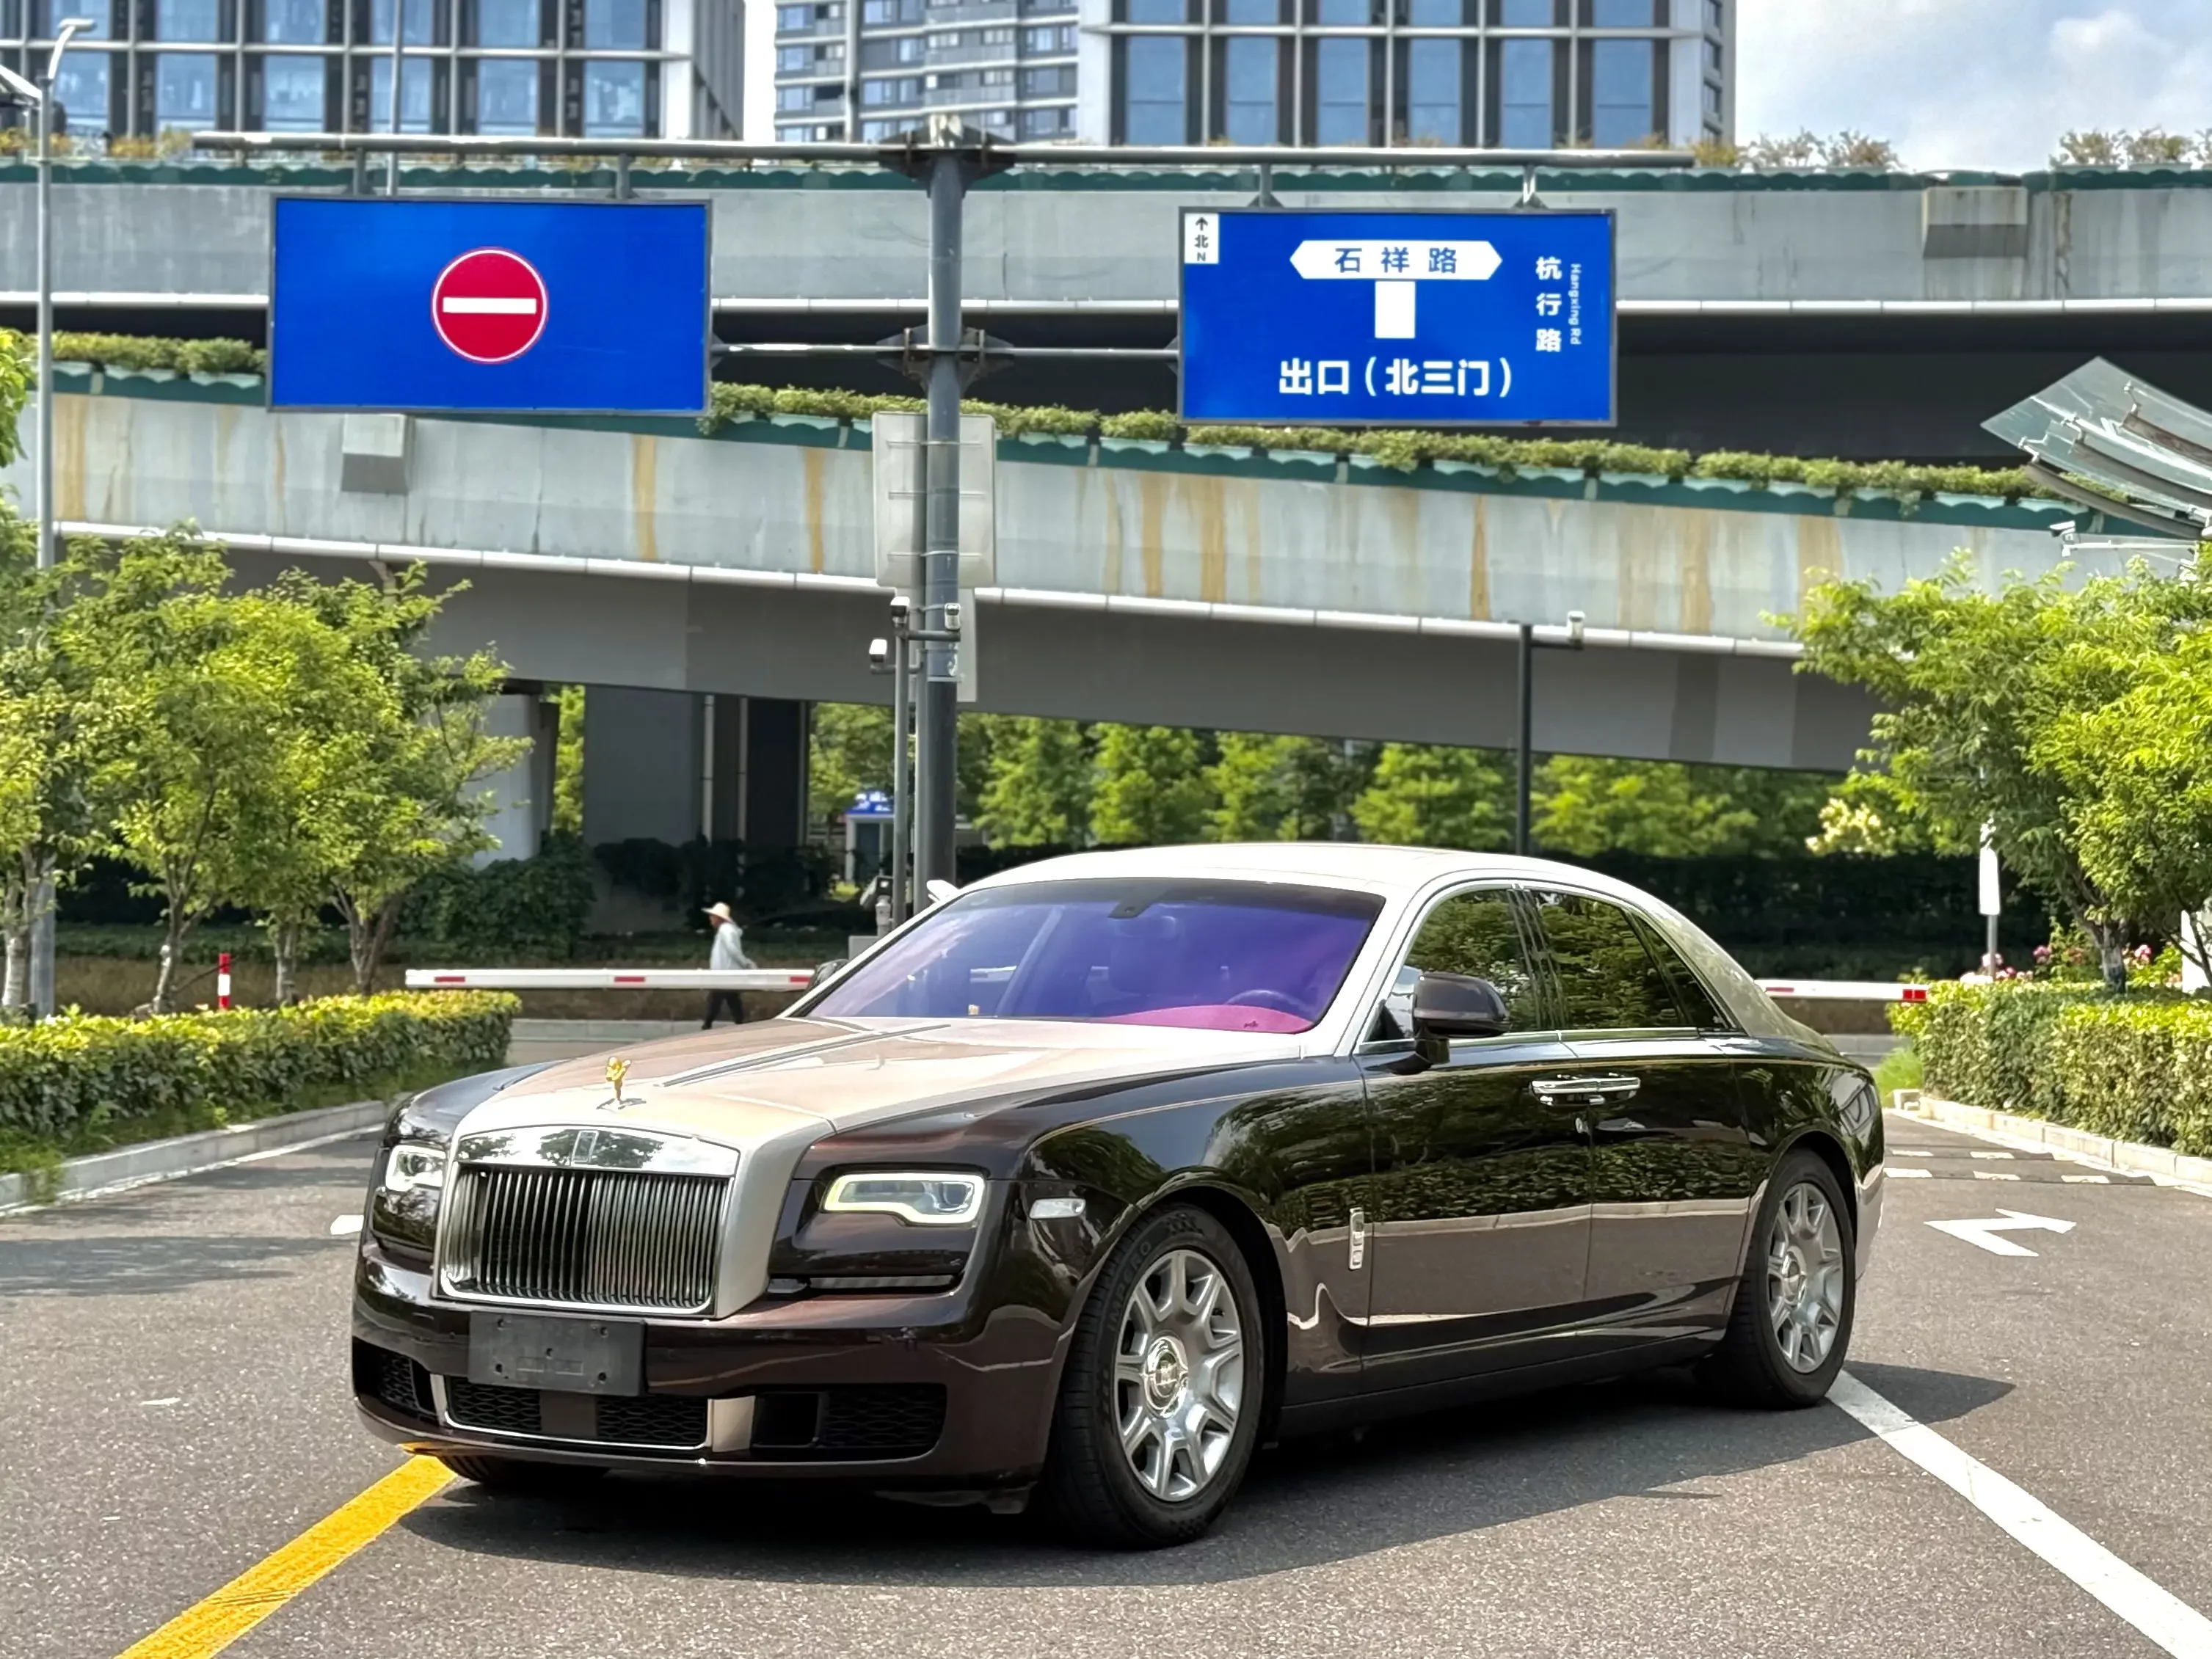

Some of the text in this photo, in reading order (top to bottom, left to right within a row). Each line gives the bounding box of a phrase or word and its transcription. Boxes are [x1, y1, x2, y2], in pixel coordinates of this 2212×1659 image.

[1194, 234, 1209, 249] 北
[1196, 252, 1207, 262] N
[1334, 247, 1458, 274] 石祥路
[1535, 256, 1562, 352] 杭行路
[1568, 263, 1582, 345] Hangxing Rd
